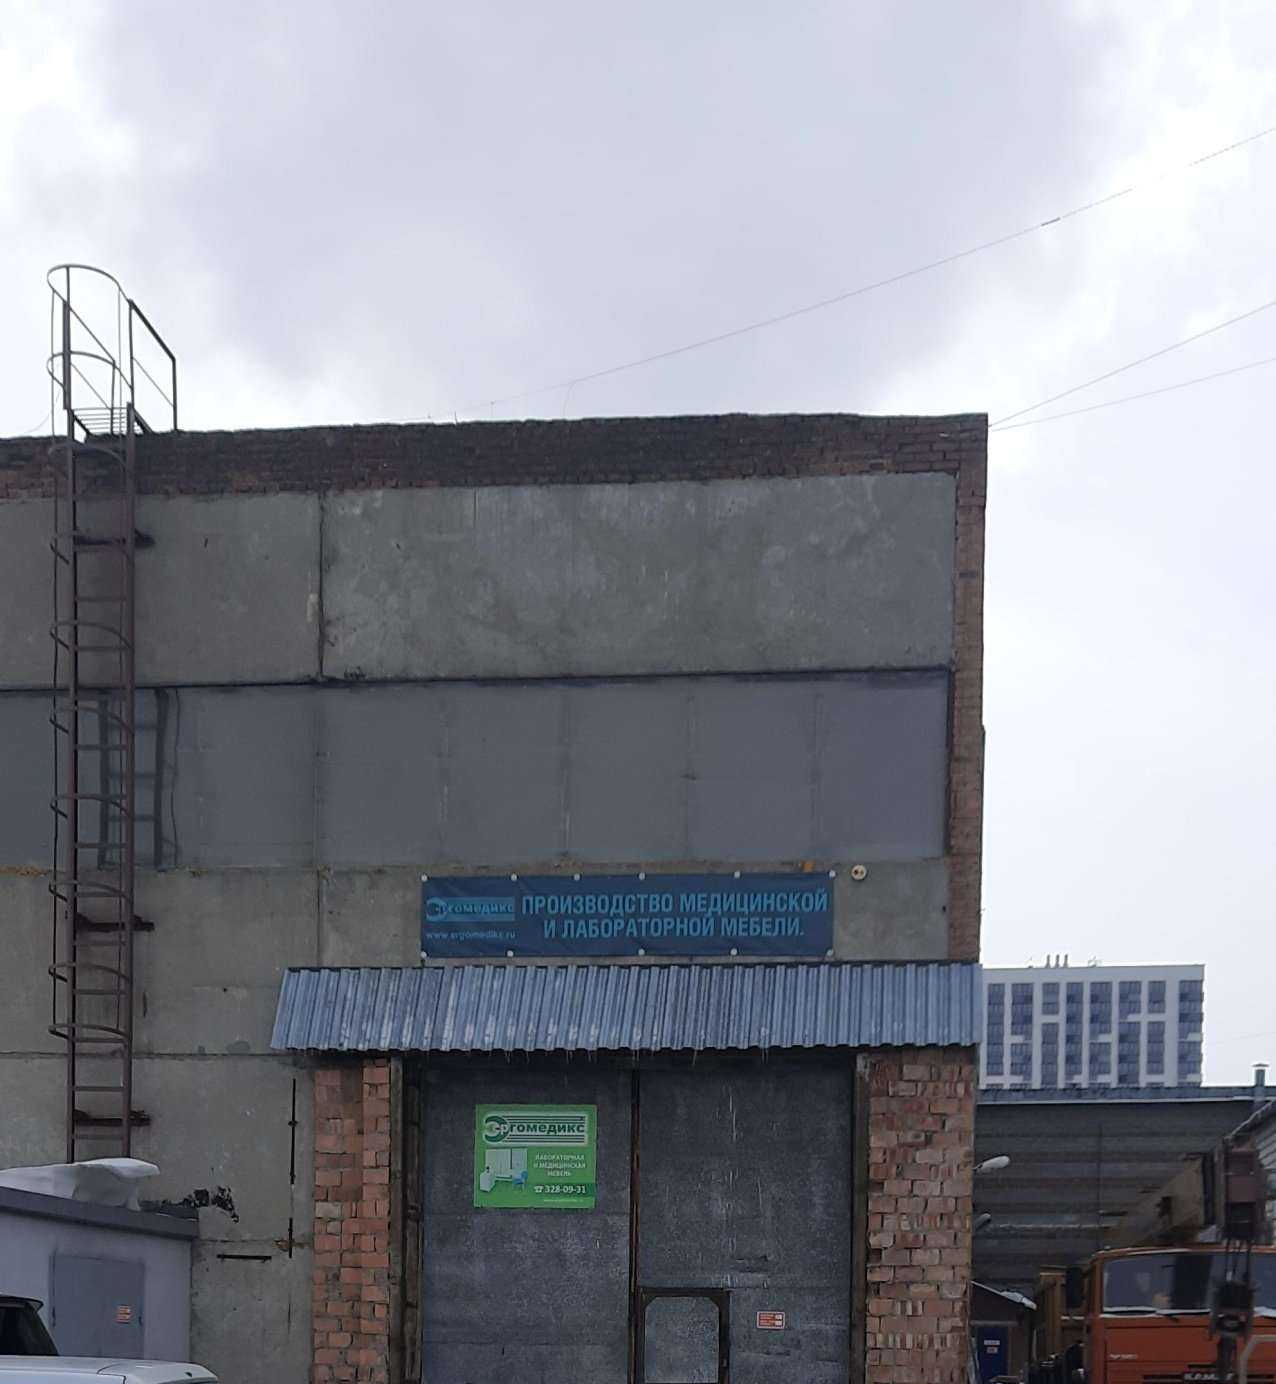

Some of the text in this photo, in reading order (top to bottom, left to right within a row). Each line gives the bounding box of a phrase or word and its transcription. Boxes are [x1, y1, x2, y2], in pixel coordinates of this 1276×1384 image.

[522, 888, 828, 917] ПРОИЗВОДСТВО МЕДИЦИНСКОЙ
[543, 912, 804, 938] И ЛАБОРАТОРНОЙ МЕБЕЛИ.
[545, 1184, 586, 1194] 328-09-31
